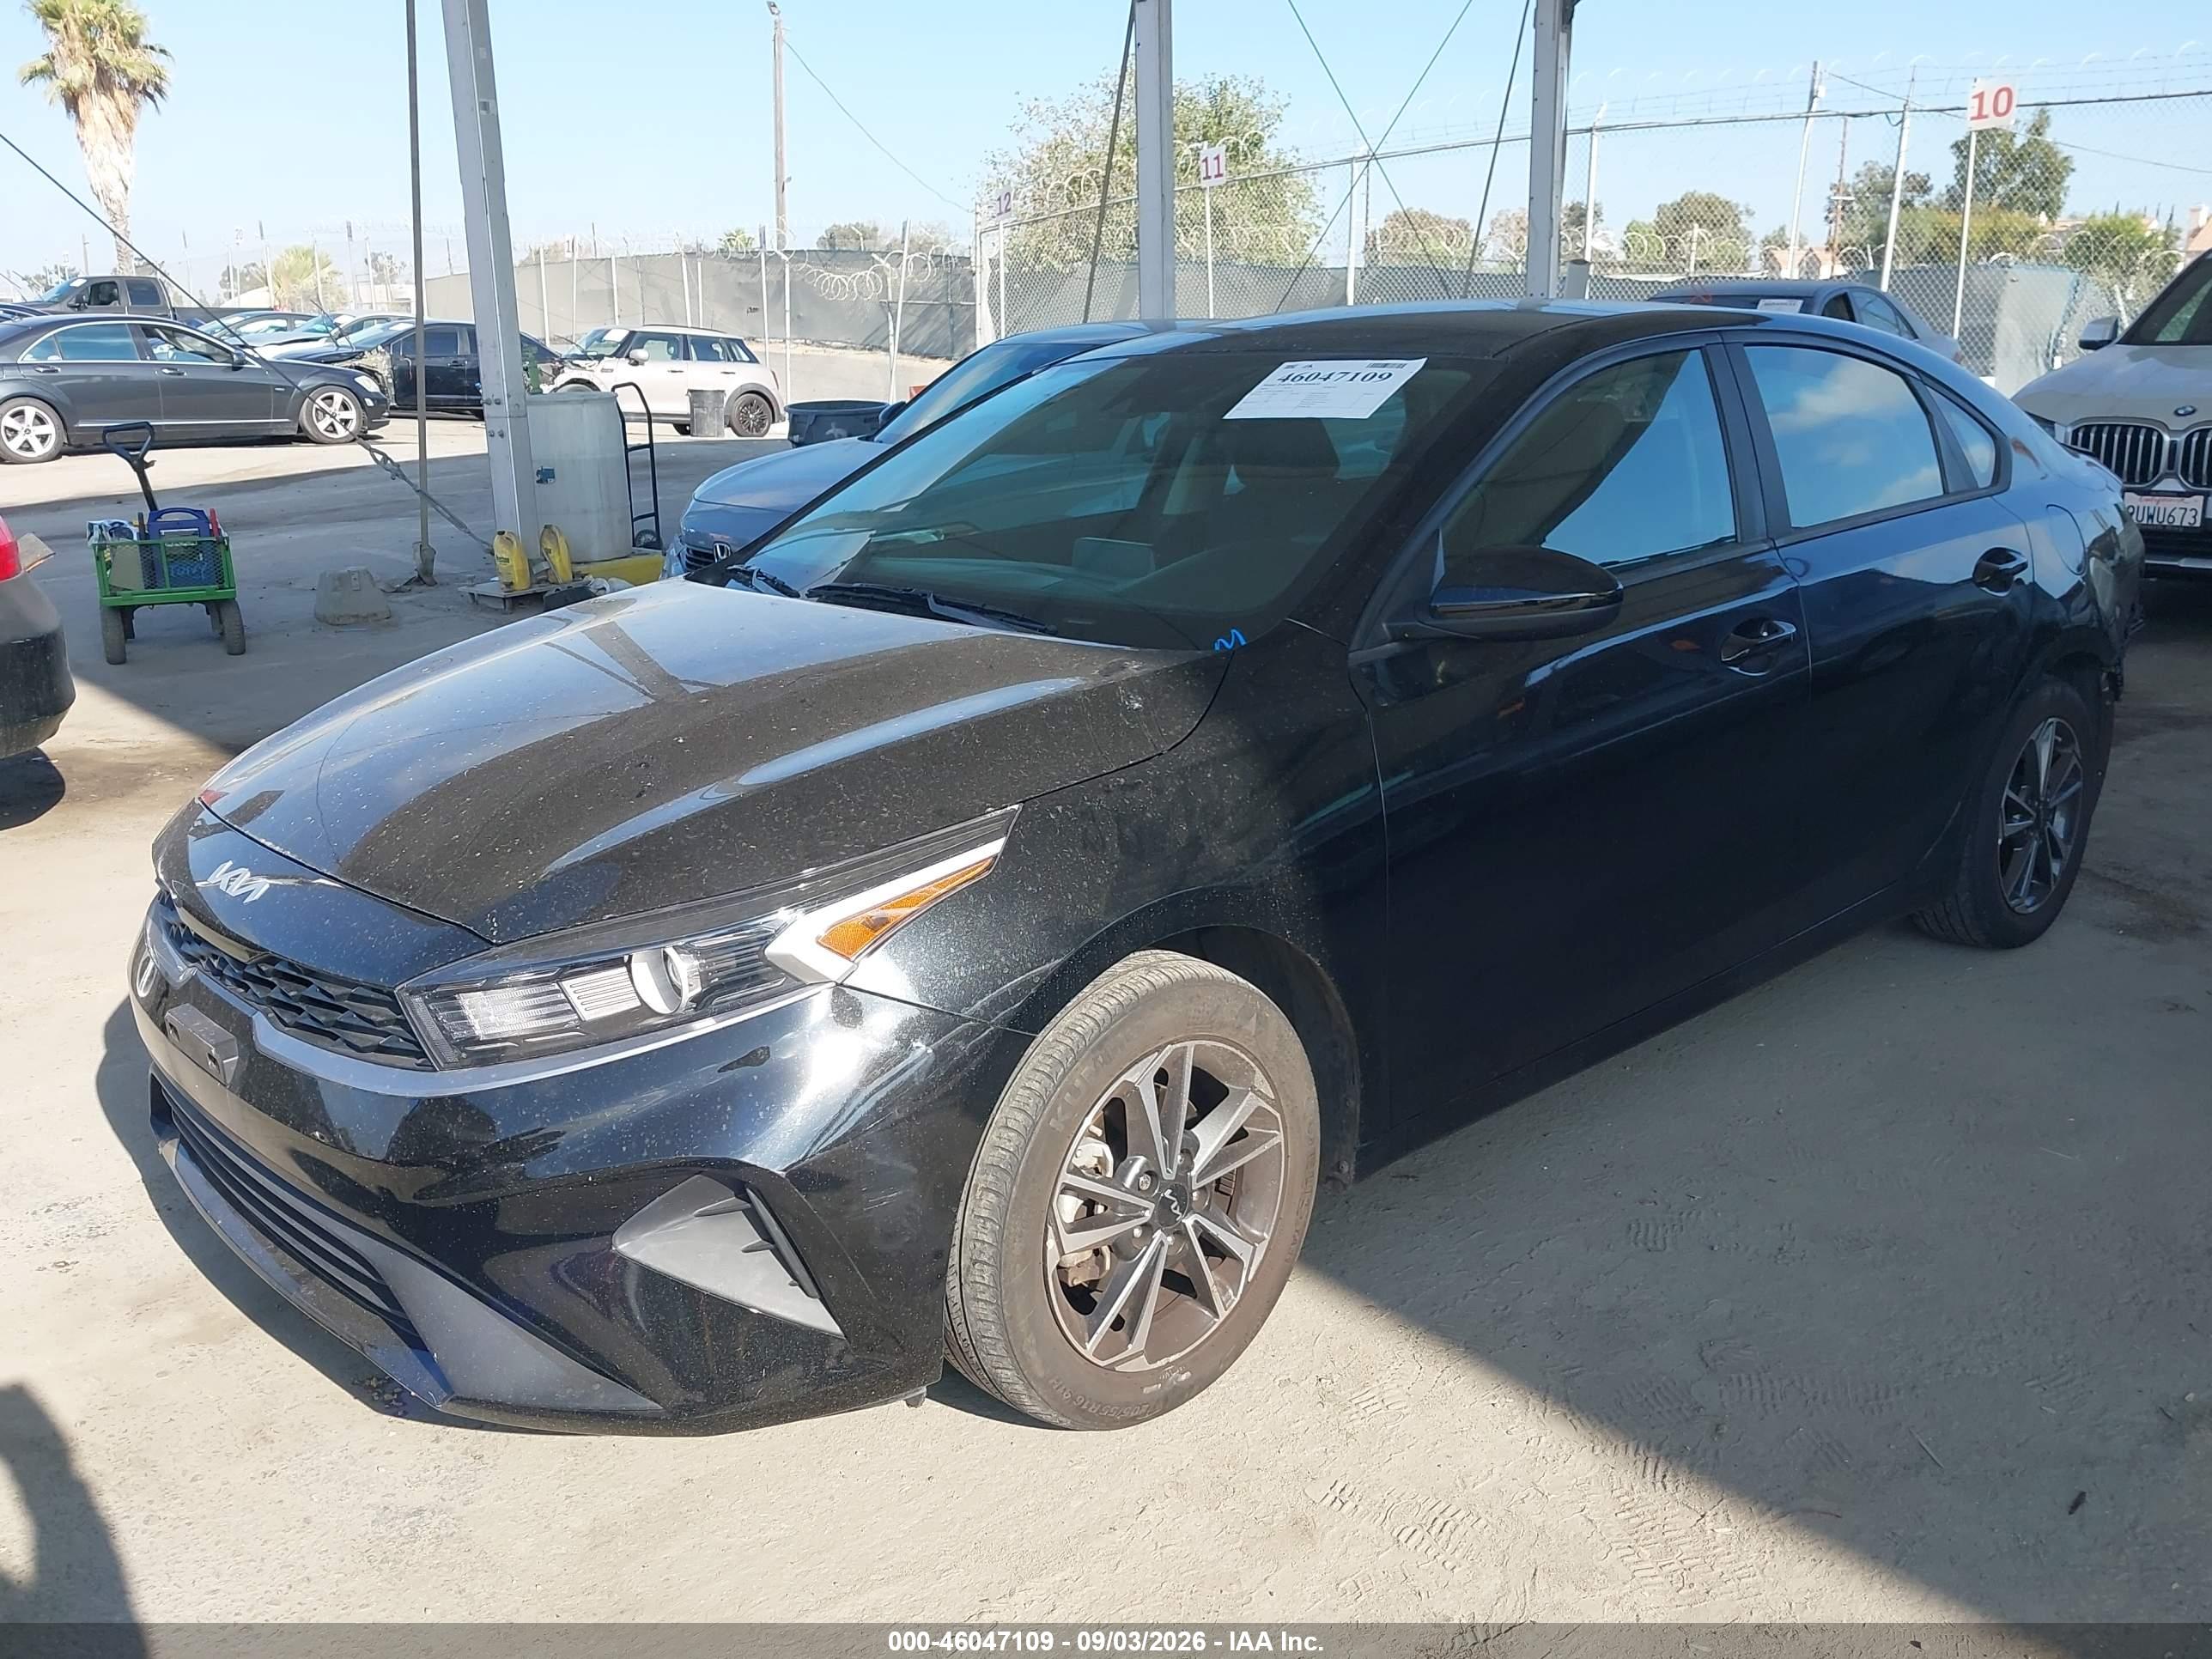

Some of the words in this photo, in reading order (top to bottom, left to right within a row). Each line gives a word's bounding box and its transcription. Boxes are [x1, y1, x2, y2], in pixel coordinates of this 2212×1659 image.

[1970, 86, 2014, 121] 10
[1201, 154, 1224, 180] 11
[996, 191, 1012, 216] 12
[1277, 370, 1395, 384] 46047109
